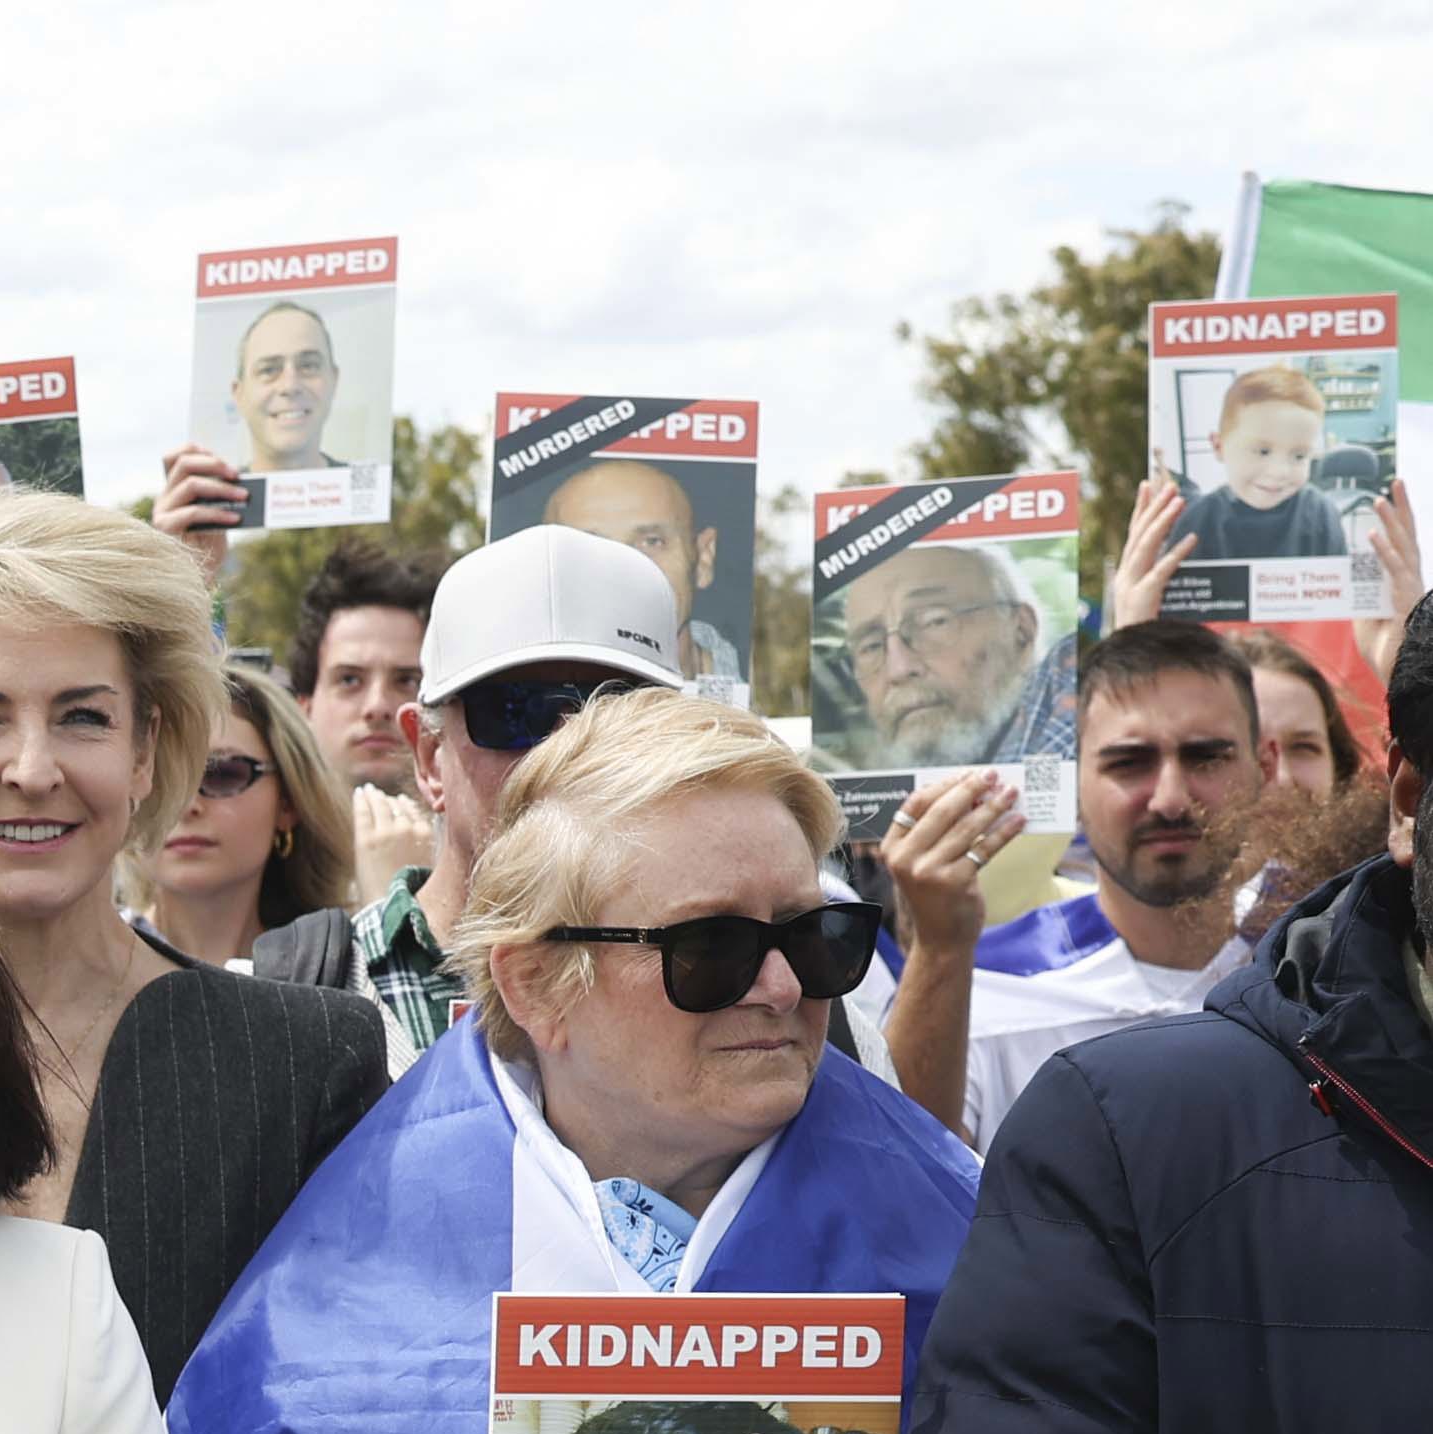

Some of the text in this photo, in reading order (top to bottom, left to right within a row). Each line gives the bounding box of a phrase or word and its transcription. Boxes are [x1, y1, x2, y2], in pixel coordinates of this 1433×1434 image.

[206, 249, 389, 287] KIDNAPPED
[1164, 308, 1385, 344] KIDNAPPED
[498, 399, 636, 479] MURDERED
[508, 407, 746, 442] KPPED
[819, 486, 953, 579] MURDERED
[827, 489, 1065, 534] KPPED
[518, 1323, 883, 1369] KIDNAPPED
